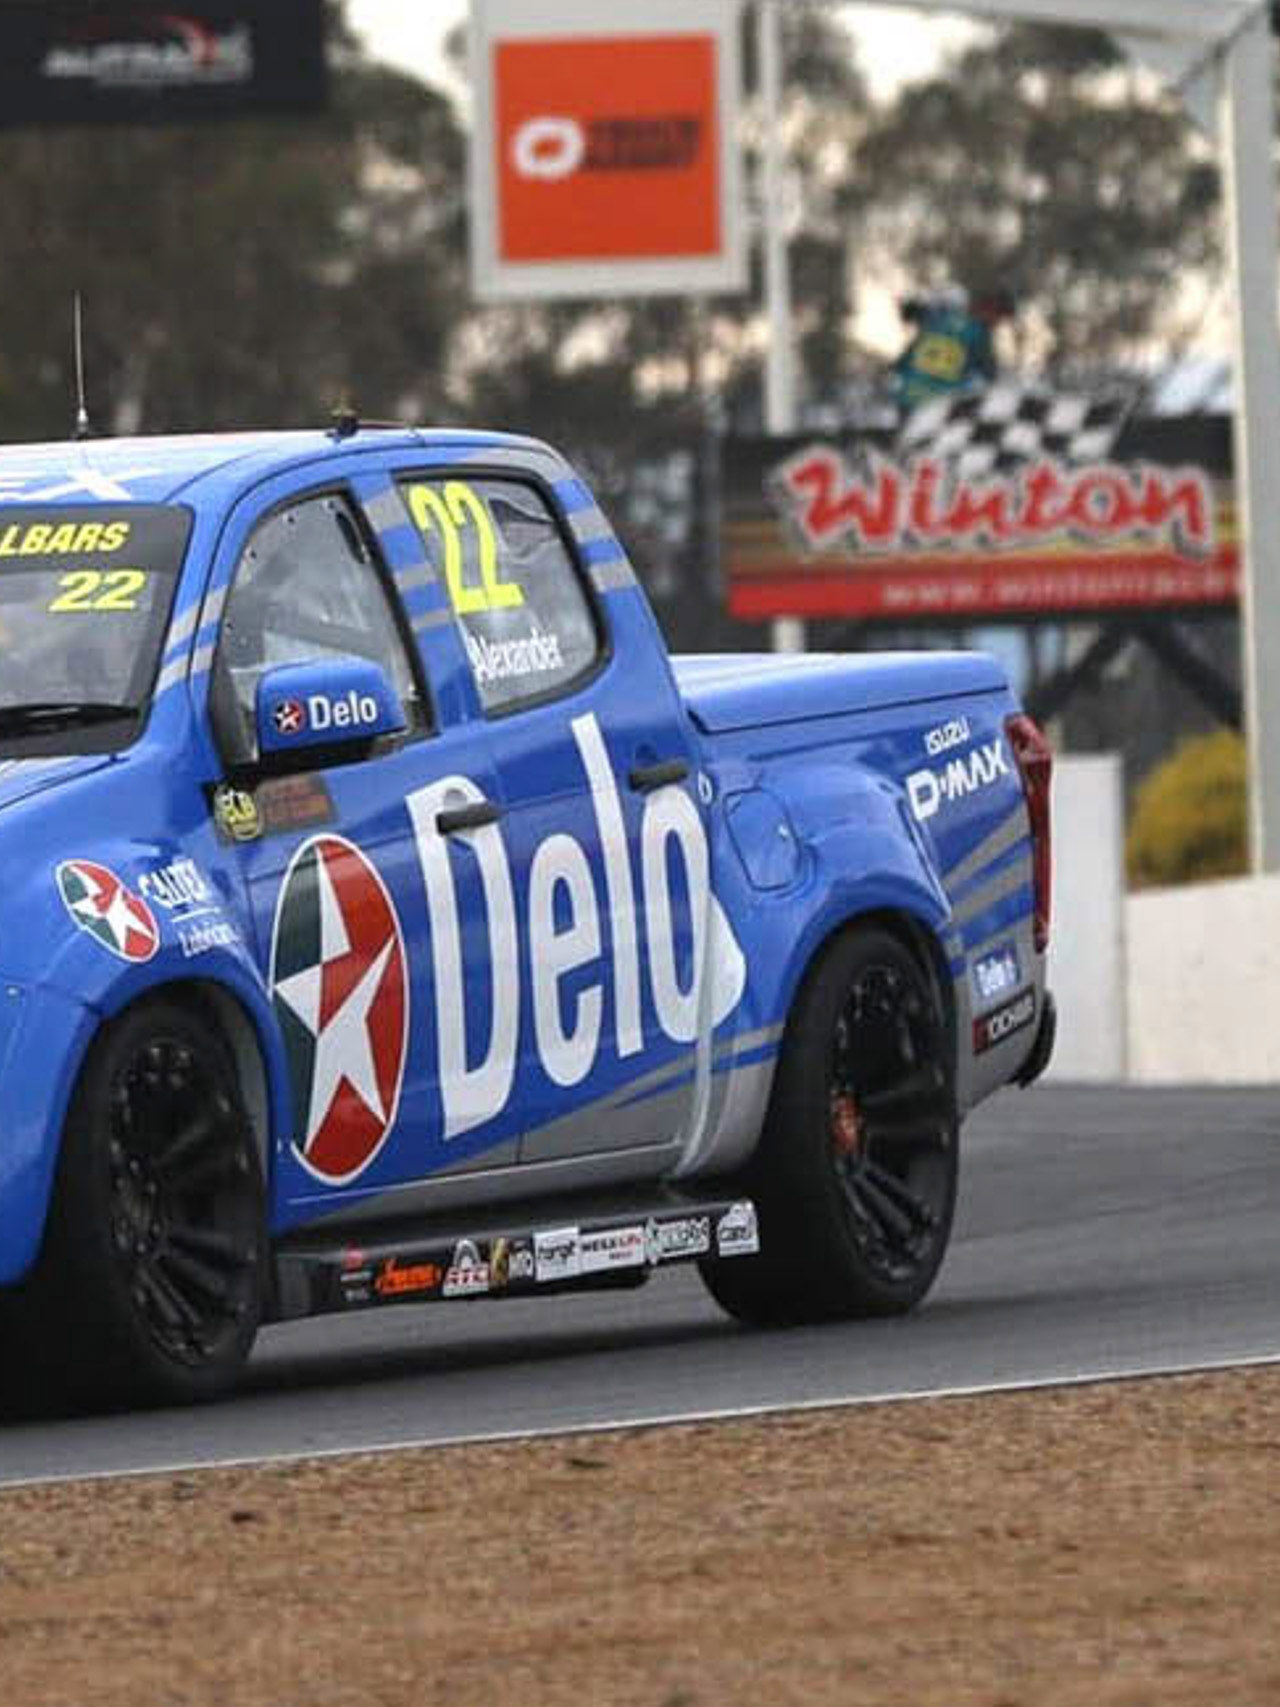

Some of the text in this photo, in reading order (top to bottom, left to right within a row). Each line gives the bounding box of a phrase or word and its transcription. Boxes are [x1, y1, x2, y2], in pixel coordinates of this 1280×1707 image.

[782, 452, 1210, 550] Winton
[408, 481, 525, 615] 22
[47, 570, 148, 613] 22
[467, 626, 564, 684] Alexander
[308, 690, 378, 730] Delo
[924, 715, 969, 755] ISUZU
[405, 711, 711, 1141] Delo
